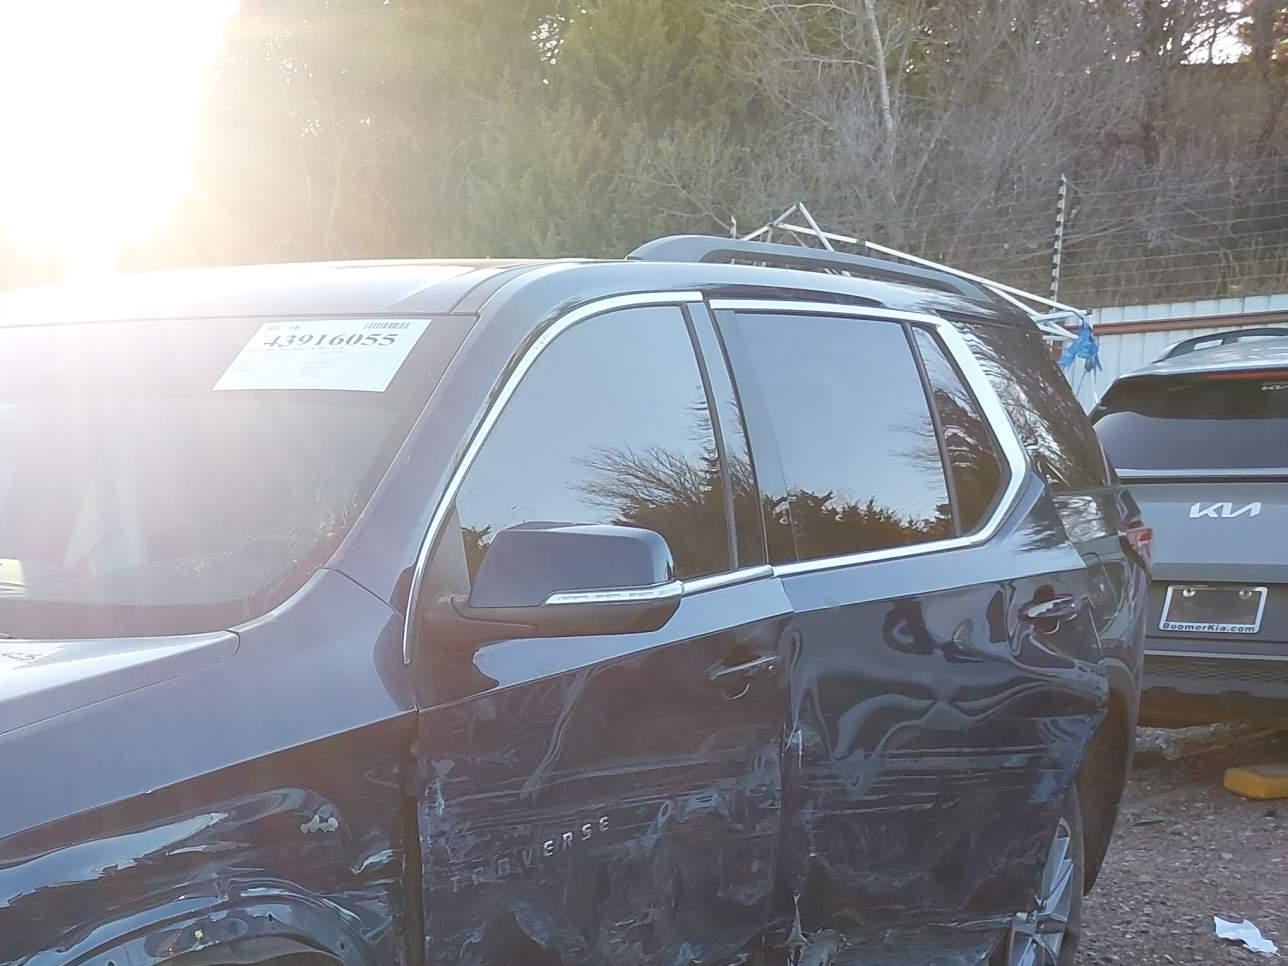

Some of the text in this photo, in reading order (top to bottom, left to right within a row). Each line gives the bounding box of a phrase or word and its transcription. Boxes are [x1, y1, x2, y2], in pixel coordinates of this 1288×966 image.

[263, 333, 398, 347] 43916055
[1189, 502, 1262, 518] KIA
[1162, 622, 1256, 634] BoomerKia.com
